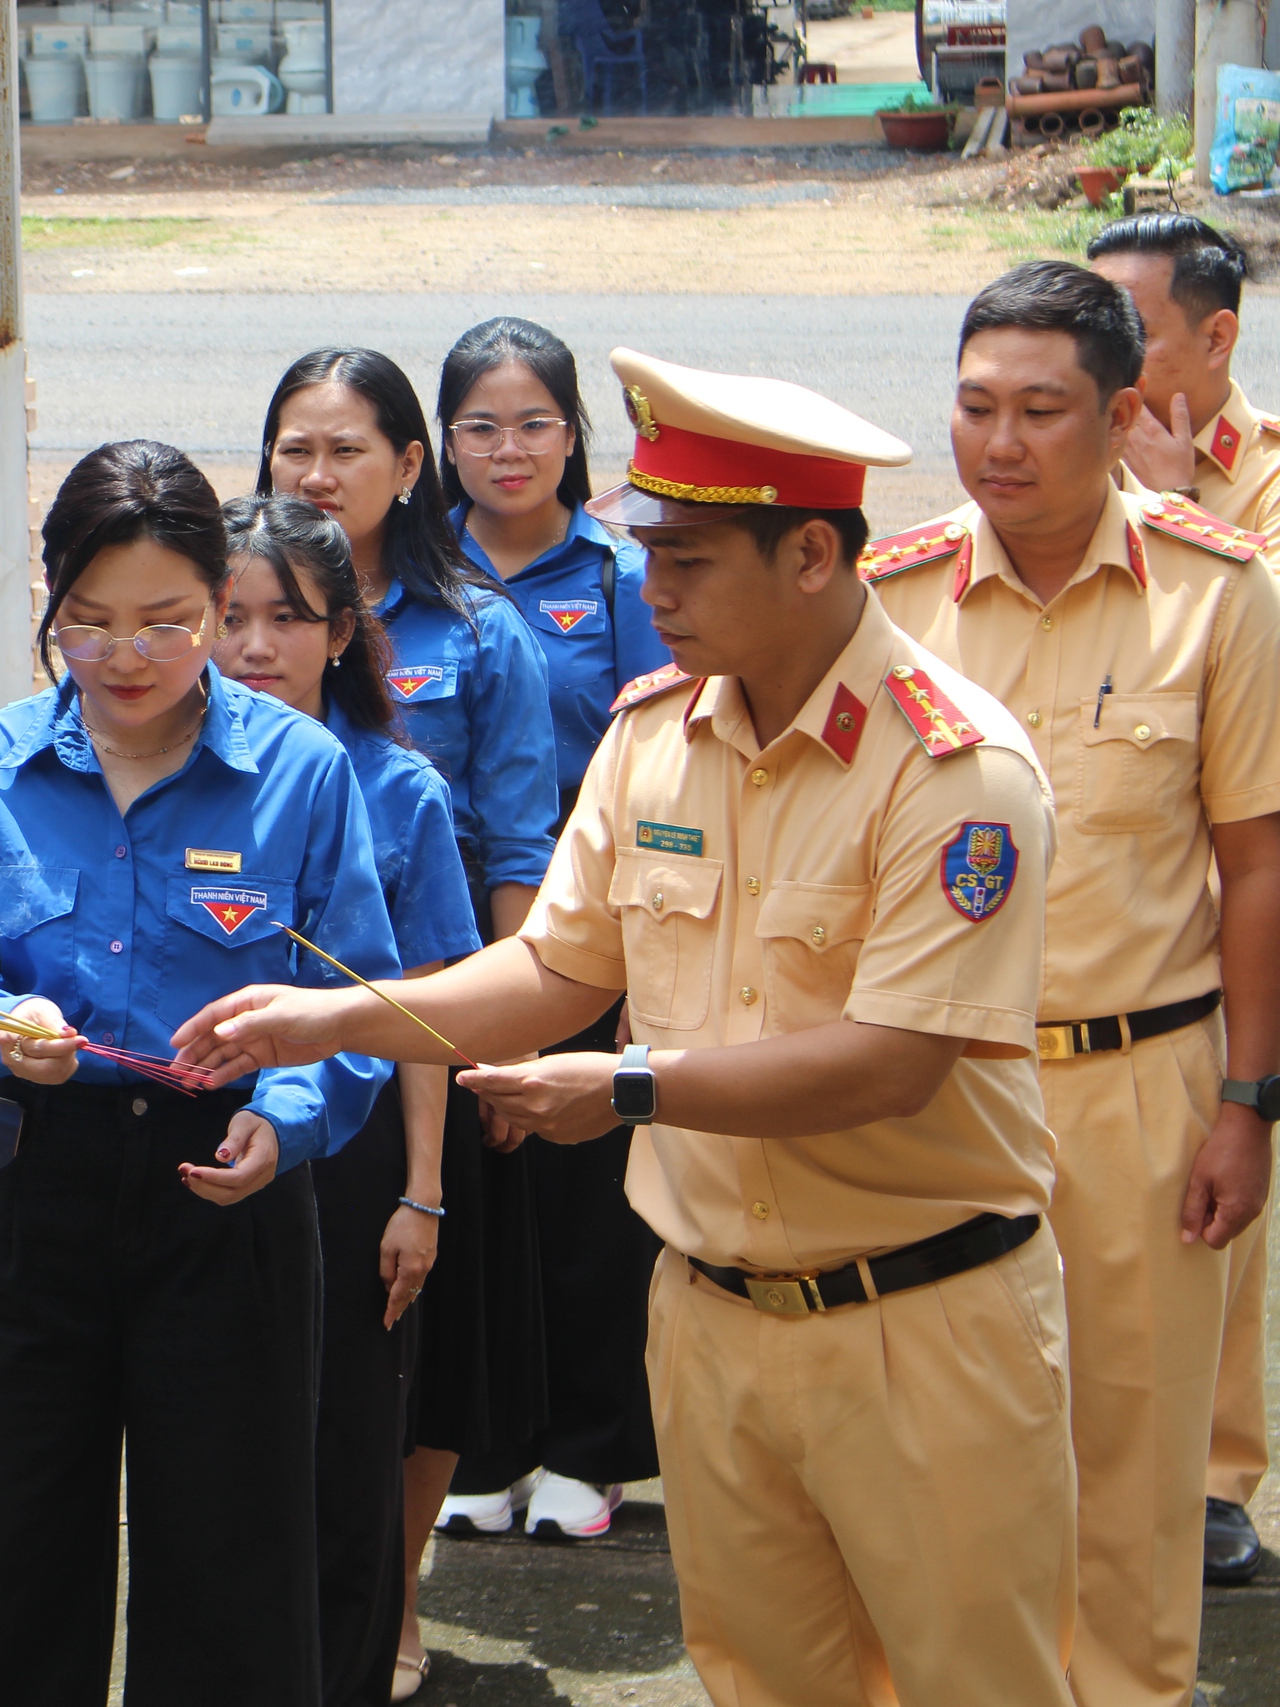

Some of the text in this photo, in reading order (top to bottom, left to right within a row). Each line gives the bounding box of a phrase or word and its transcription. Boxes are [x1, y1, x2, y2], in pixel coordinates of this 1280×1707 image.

[428, 668, 441, 676] NAM
[955, 874, 1004, 889] CS GT
[194, 891, 265, 905] THANH NIÊN VIỆT NAM
